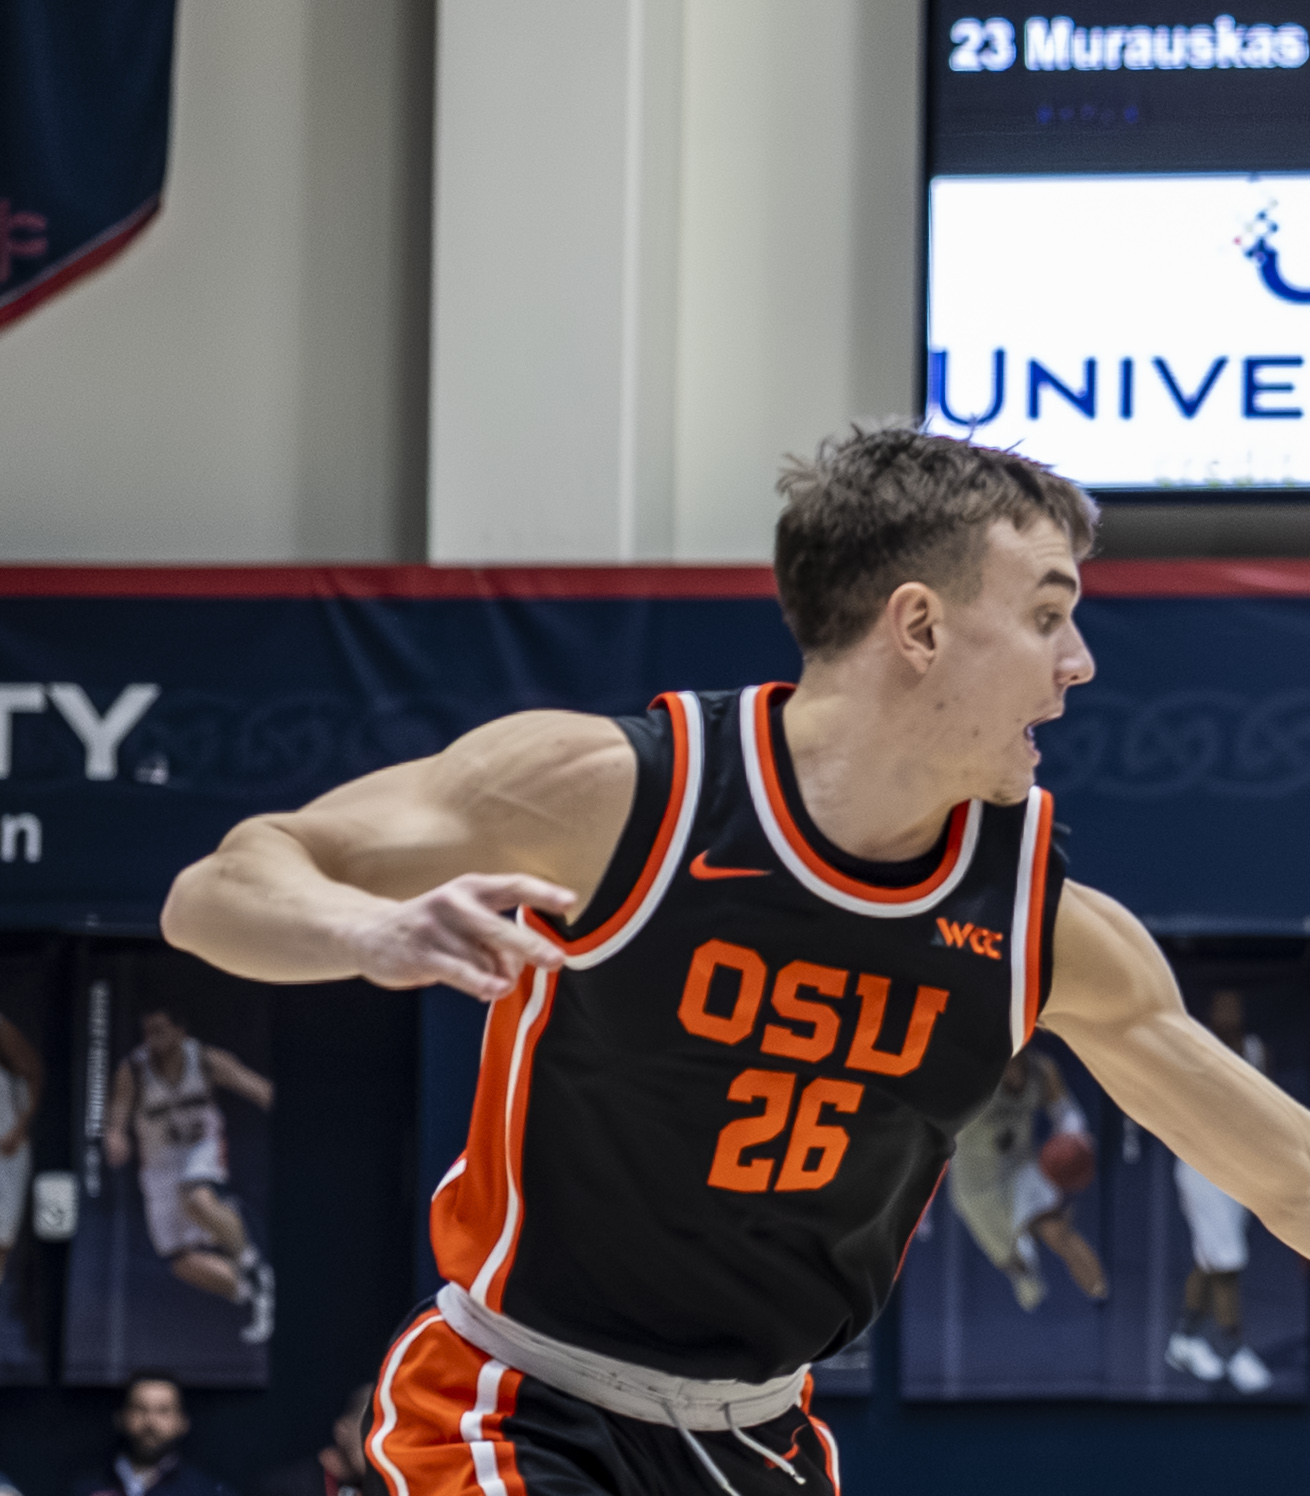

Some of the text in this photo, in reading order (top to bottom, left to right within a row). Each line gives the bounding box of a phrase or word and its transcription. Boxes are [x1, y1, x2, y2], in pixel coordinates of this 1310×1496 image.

[949, 18, 1016, 71] 23
[1024, 15, 1310, 70] Murauskas
[934, 916, 1003, 960] WCC
[677, 938, 950, 1077] OSU
[707, 1067, 866, 1193] 26
